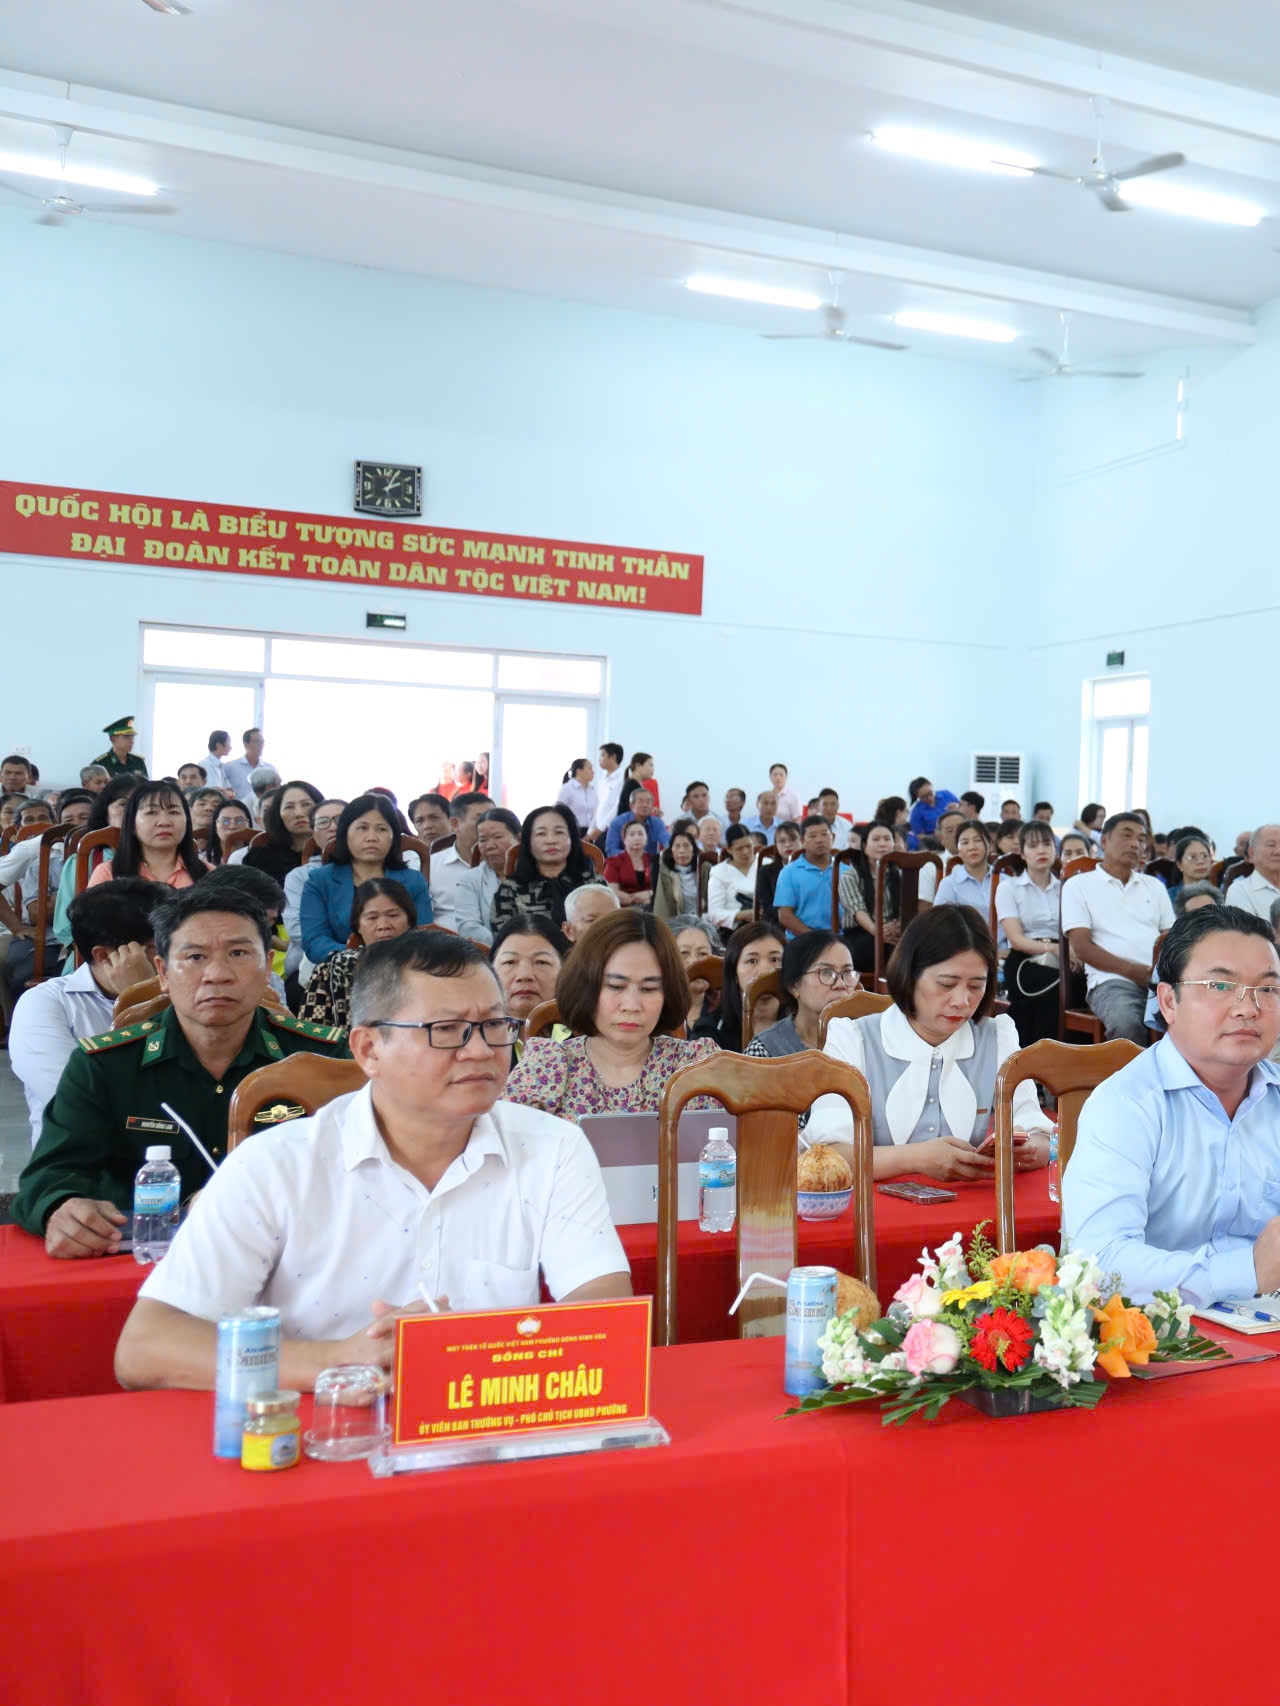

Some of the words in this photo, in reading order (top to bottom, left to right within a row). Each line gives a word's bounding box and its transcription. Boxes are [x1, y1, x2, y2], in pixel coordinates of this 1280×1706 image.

[364, 480, 372, 490] 9
[15, 493, 99, 520] QUỐC
[109, 502, 163, 530] HỘI
[171, 509, 211, 533] LÀ
[219, 511, 287, 539] BIỂU
[296, 522, 394, 550] TƯỢNG
[402, 532, 455, 556] SỨC
[463, 539, 545, 565] MẠNH
[552, 549, 615, 572] TINH
[621, 554, 691, 580] THẦN
[71, 532, 126, 558] ĐẠI
[144, 539, 230, 565] ĐOÀN
[238, 544, 295, 572] KẾT
[303, 554, 381, 579] TOÀN
[388, 560, 448, 586] DÂN
[455, 567, 505, 593] TỘC
[512, 573, 570, 599] VIỆT
[576, 580, 647, 604] NAM!
[492, 1350, 534, 1363] ĐỒNG
[538, 1347, 564, 1360] CHÍ
[448, 1374, 474, 1410] LÊ
[481, 1371, 539, 1406] MINH
[545, 1365, 603, 1400] CHÂU
[452, 1419, 469, 1431] BAN
[504, 1414, 514, 1428] VỤ
[520, 1411, 536, 1425] PHÓ
[555, 1409, 572, 1423] TỊCH
[596, 1404, 627, 1417] PHƯỜNG
